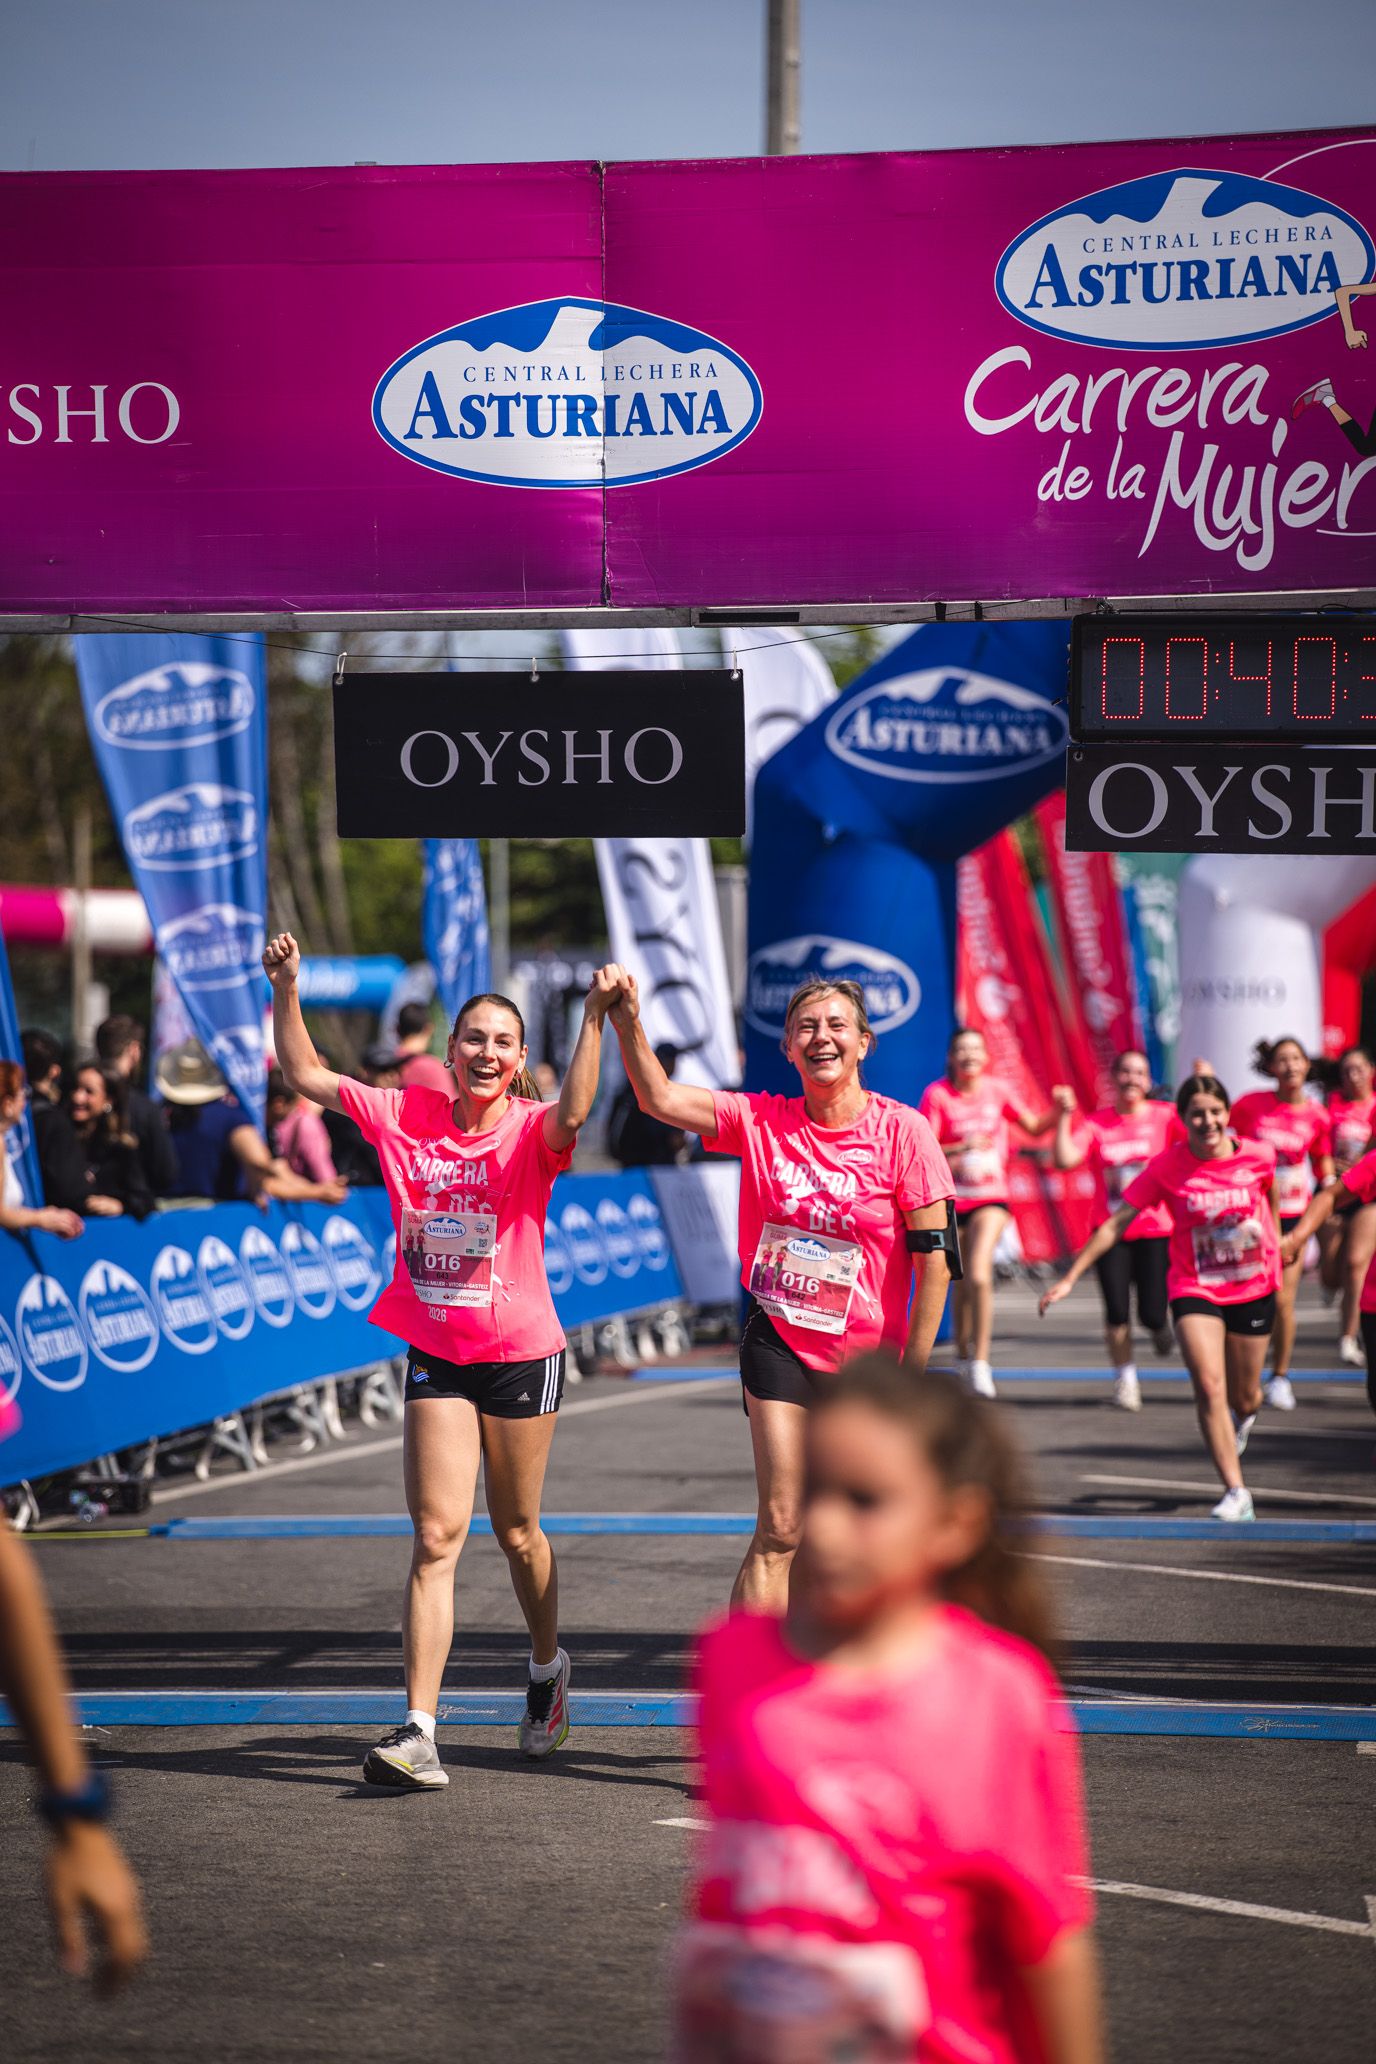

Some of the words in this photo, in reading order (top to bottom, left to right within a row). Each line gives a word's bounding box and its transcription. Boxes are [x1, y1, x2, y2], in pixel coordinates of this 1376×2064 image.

[1083, 231, 1200, 254] CENTRAL
[1213, 224, 1334, 247] LECHERA
[1024, 243, 1343, 309] ASTURIANA
[463, 364, 586, 383] CENTRAL
[600, 362, 719, 381] LECHERA
[402, 370, 733, 441] ASTURIANA
[963, 345, 1270, 436] Carrera
[0, 381, 181, 446] SHO
[1037, 439, 1093, 502] de
[1106, 434, 1147, 499] la
[1137, 417, 1376, 572] Mujer
[841, 706, 1055, 757] ASTURIANA
[400, 726, 684, 788] OYSHO
[1088, 762, 1376, 840] OYSH
[411, 1156, 489, 1187] CARRERA
[426, 1224, 463, 1235] ASTURIANA
[424, 1253, 461, 1271] 016
[791, 1242, 828, 1259] ASTURIANA
[449, 1293, 481, 1302] Santander
[781, 1271, 821, 1294] 016
[427, 1305, 448, 1323] 2026
[803, 1315, 833, 1327] Santander
